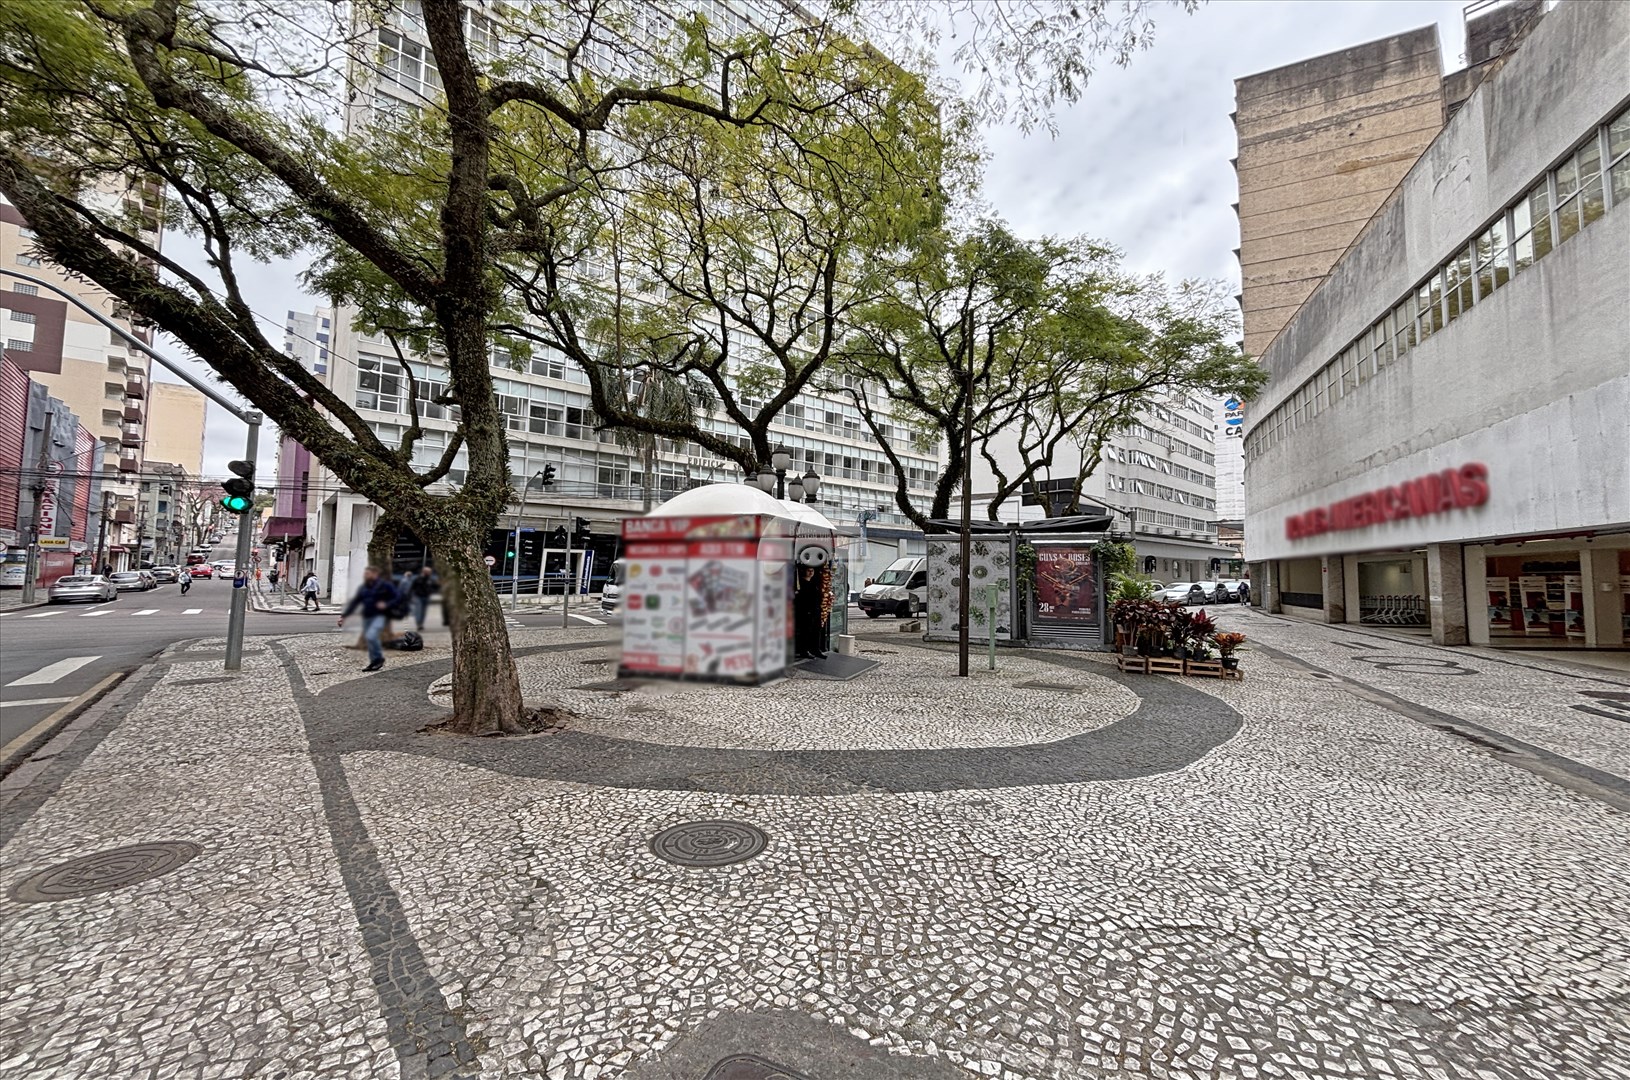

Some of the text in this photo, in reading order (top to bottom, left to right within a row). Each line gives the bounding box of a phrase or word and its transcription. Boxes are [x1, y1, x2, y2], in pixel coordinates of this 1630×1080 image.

[1039, 553, 1058, 561] GUNS
[1068, 553, 1091, 561] ROSES
[1039, 602, 1049, 612] 28
